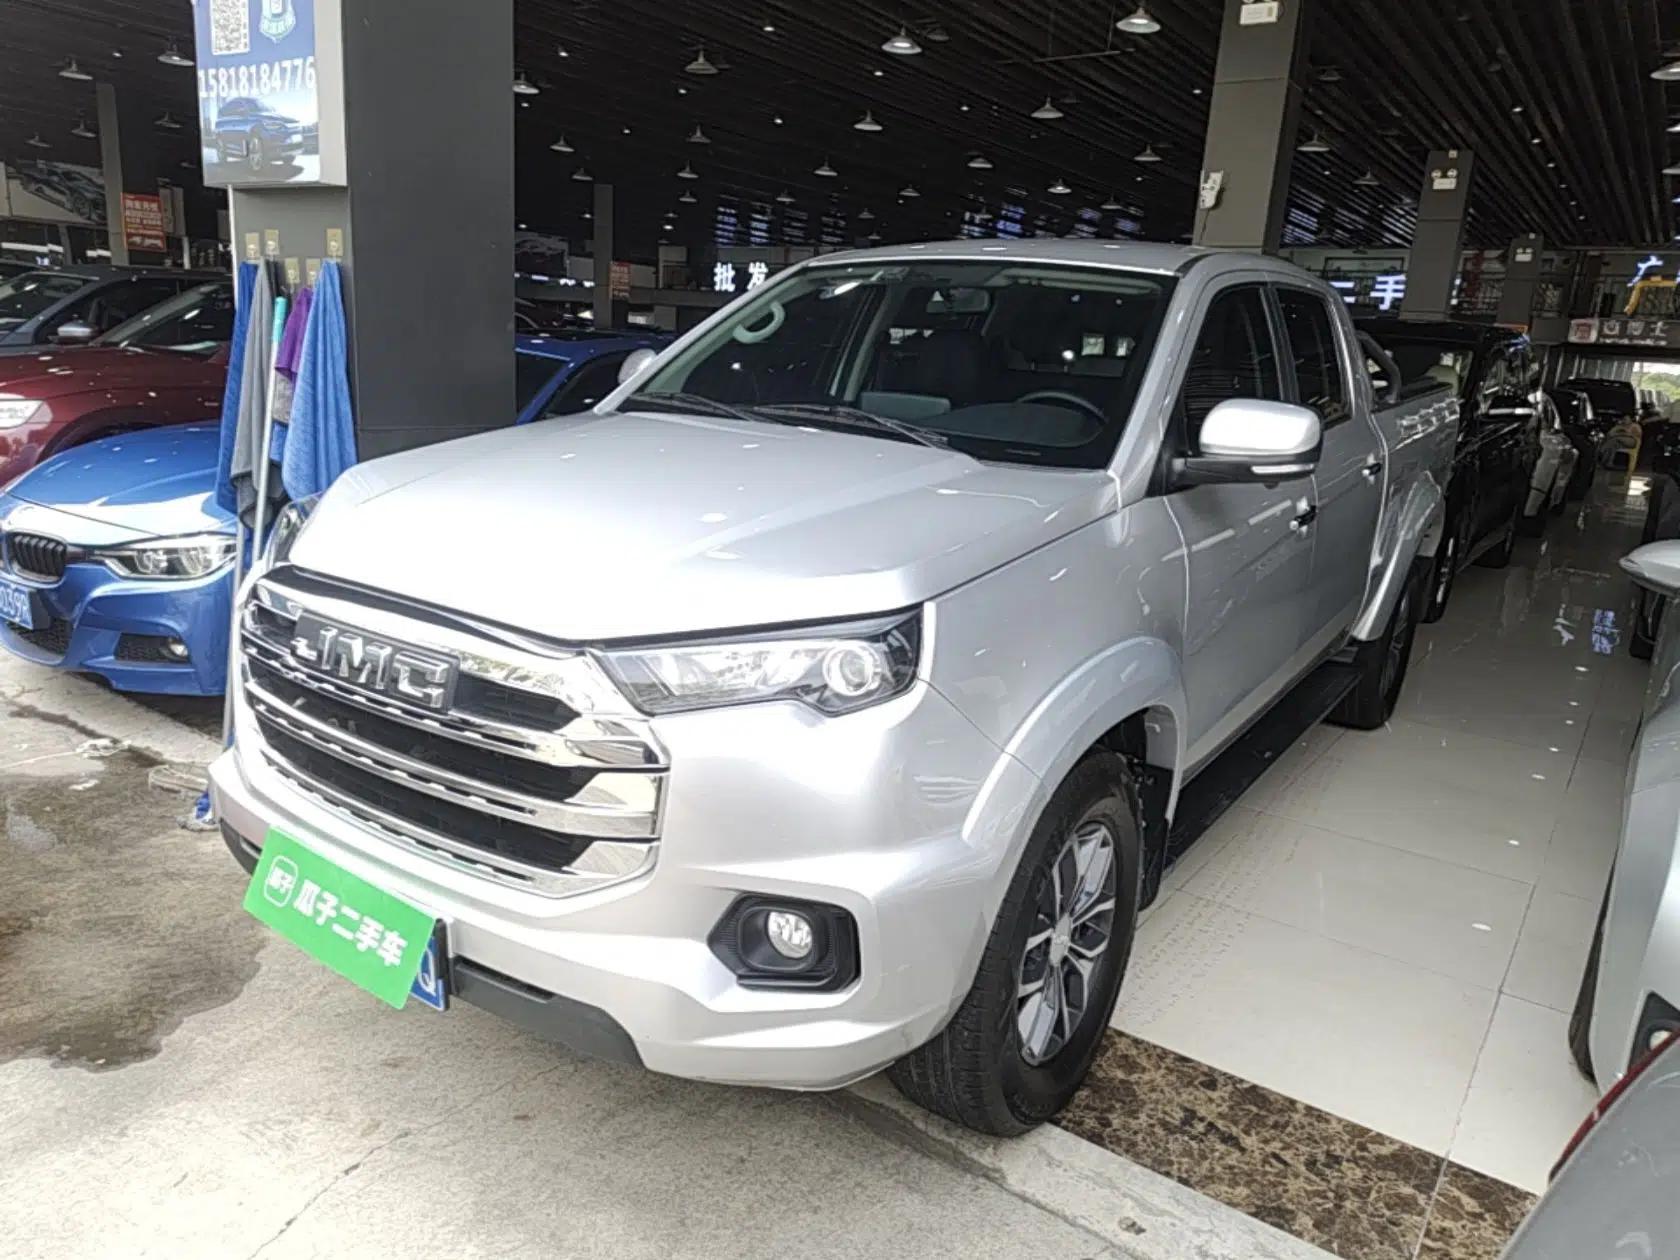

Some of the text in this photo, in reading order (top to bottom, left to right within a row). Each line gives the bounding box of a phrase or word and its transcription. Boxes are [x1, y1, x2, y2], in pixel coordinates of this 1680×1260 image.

[198, 56, 317, 98] 15818184776
[713, 262, 769, 292] 批发
[290, 626, 450, 709] JMC
[293, 879, 409, 967] 瓜子二手车
